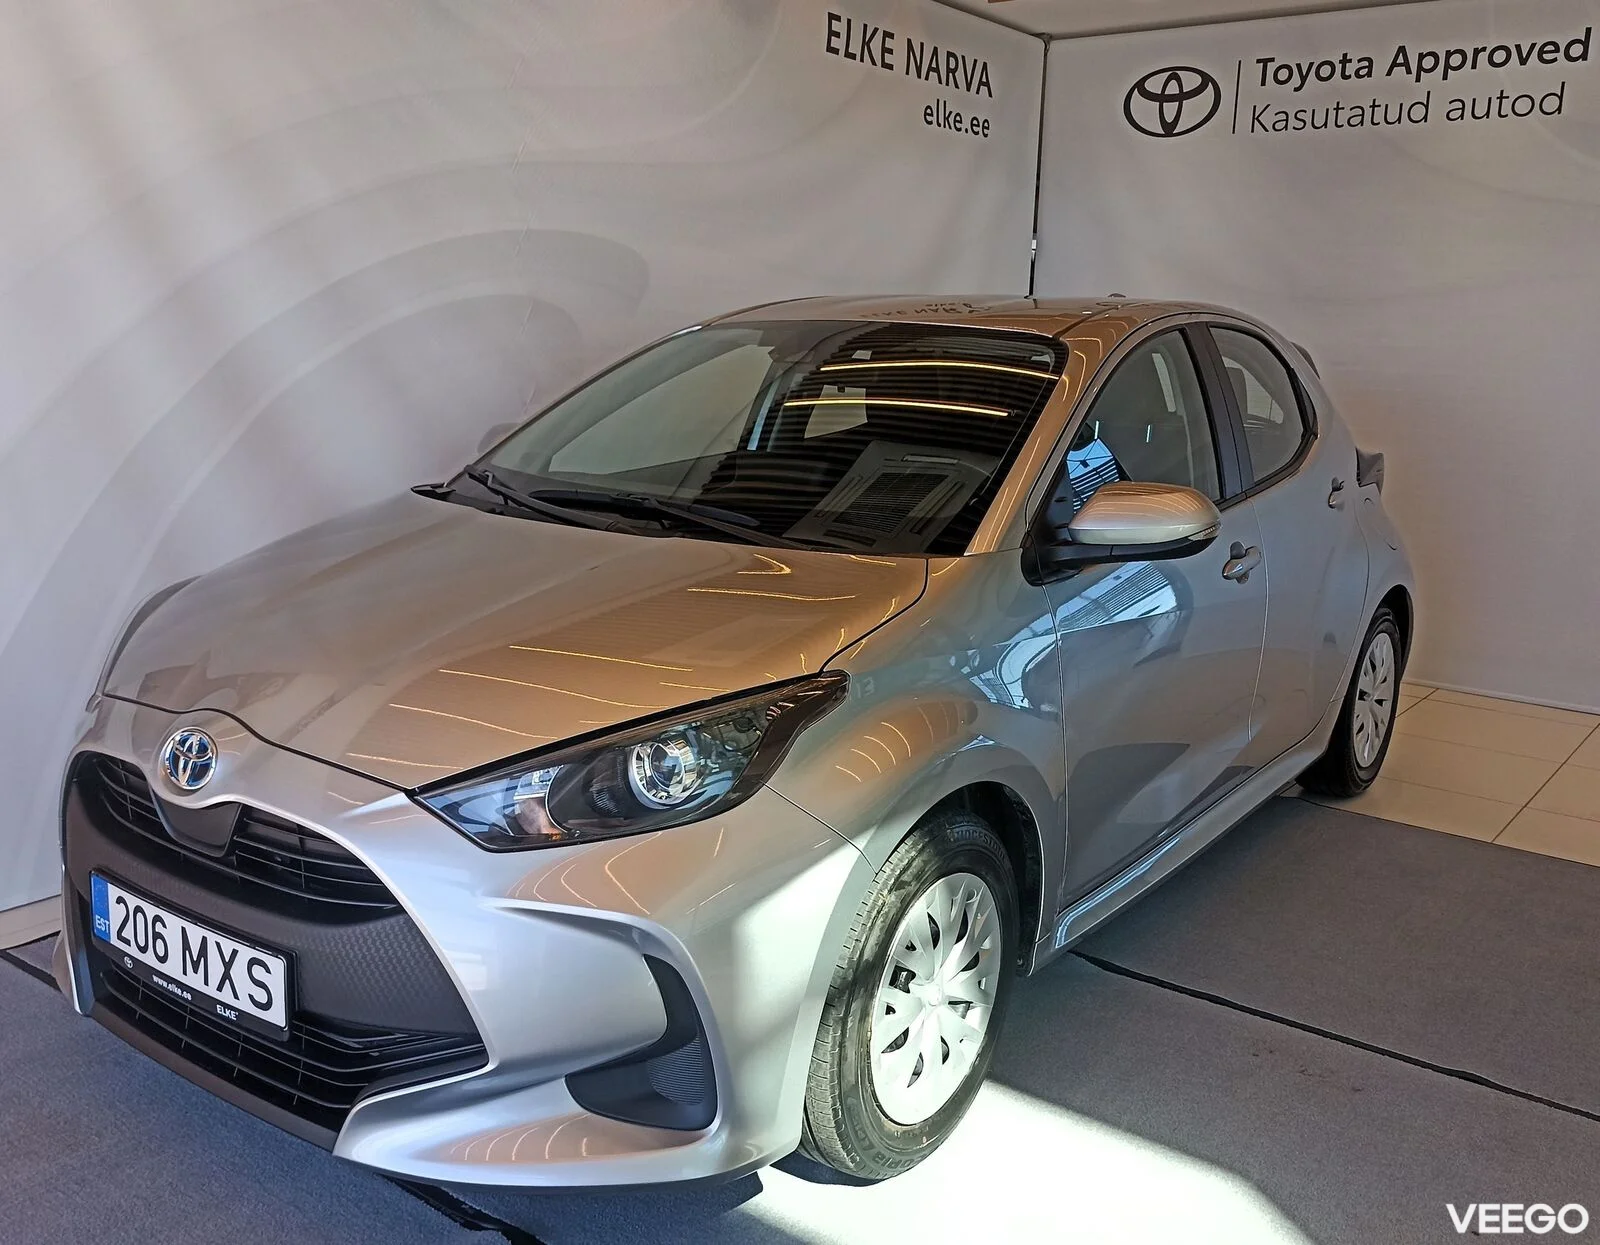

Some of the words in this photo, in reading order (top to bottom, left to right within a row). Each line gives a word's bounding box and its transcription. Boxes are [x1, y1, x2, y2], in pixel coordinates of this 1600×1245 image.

[826, 12, 895, 71] ELKE
[905, 38, 993, 98] NARVA
[1255, 52, 1374, 92] Toyota
[1385, 27, 1592, 83] Approved
[923, 99, 990, 138] elke.ee
[1250, 91, 1431, 133] Kasutatud
[1445, 81, 1566, 121] autod
[95, 914, 110, 934] EST
[115, 895, 169, 965] 206
[181, 925, 274, 1012] MXS
[152, 974, 193, 1001] www.elke.ee
[216, 1004, 238, 1021] ELKE
